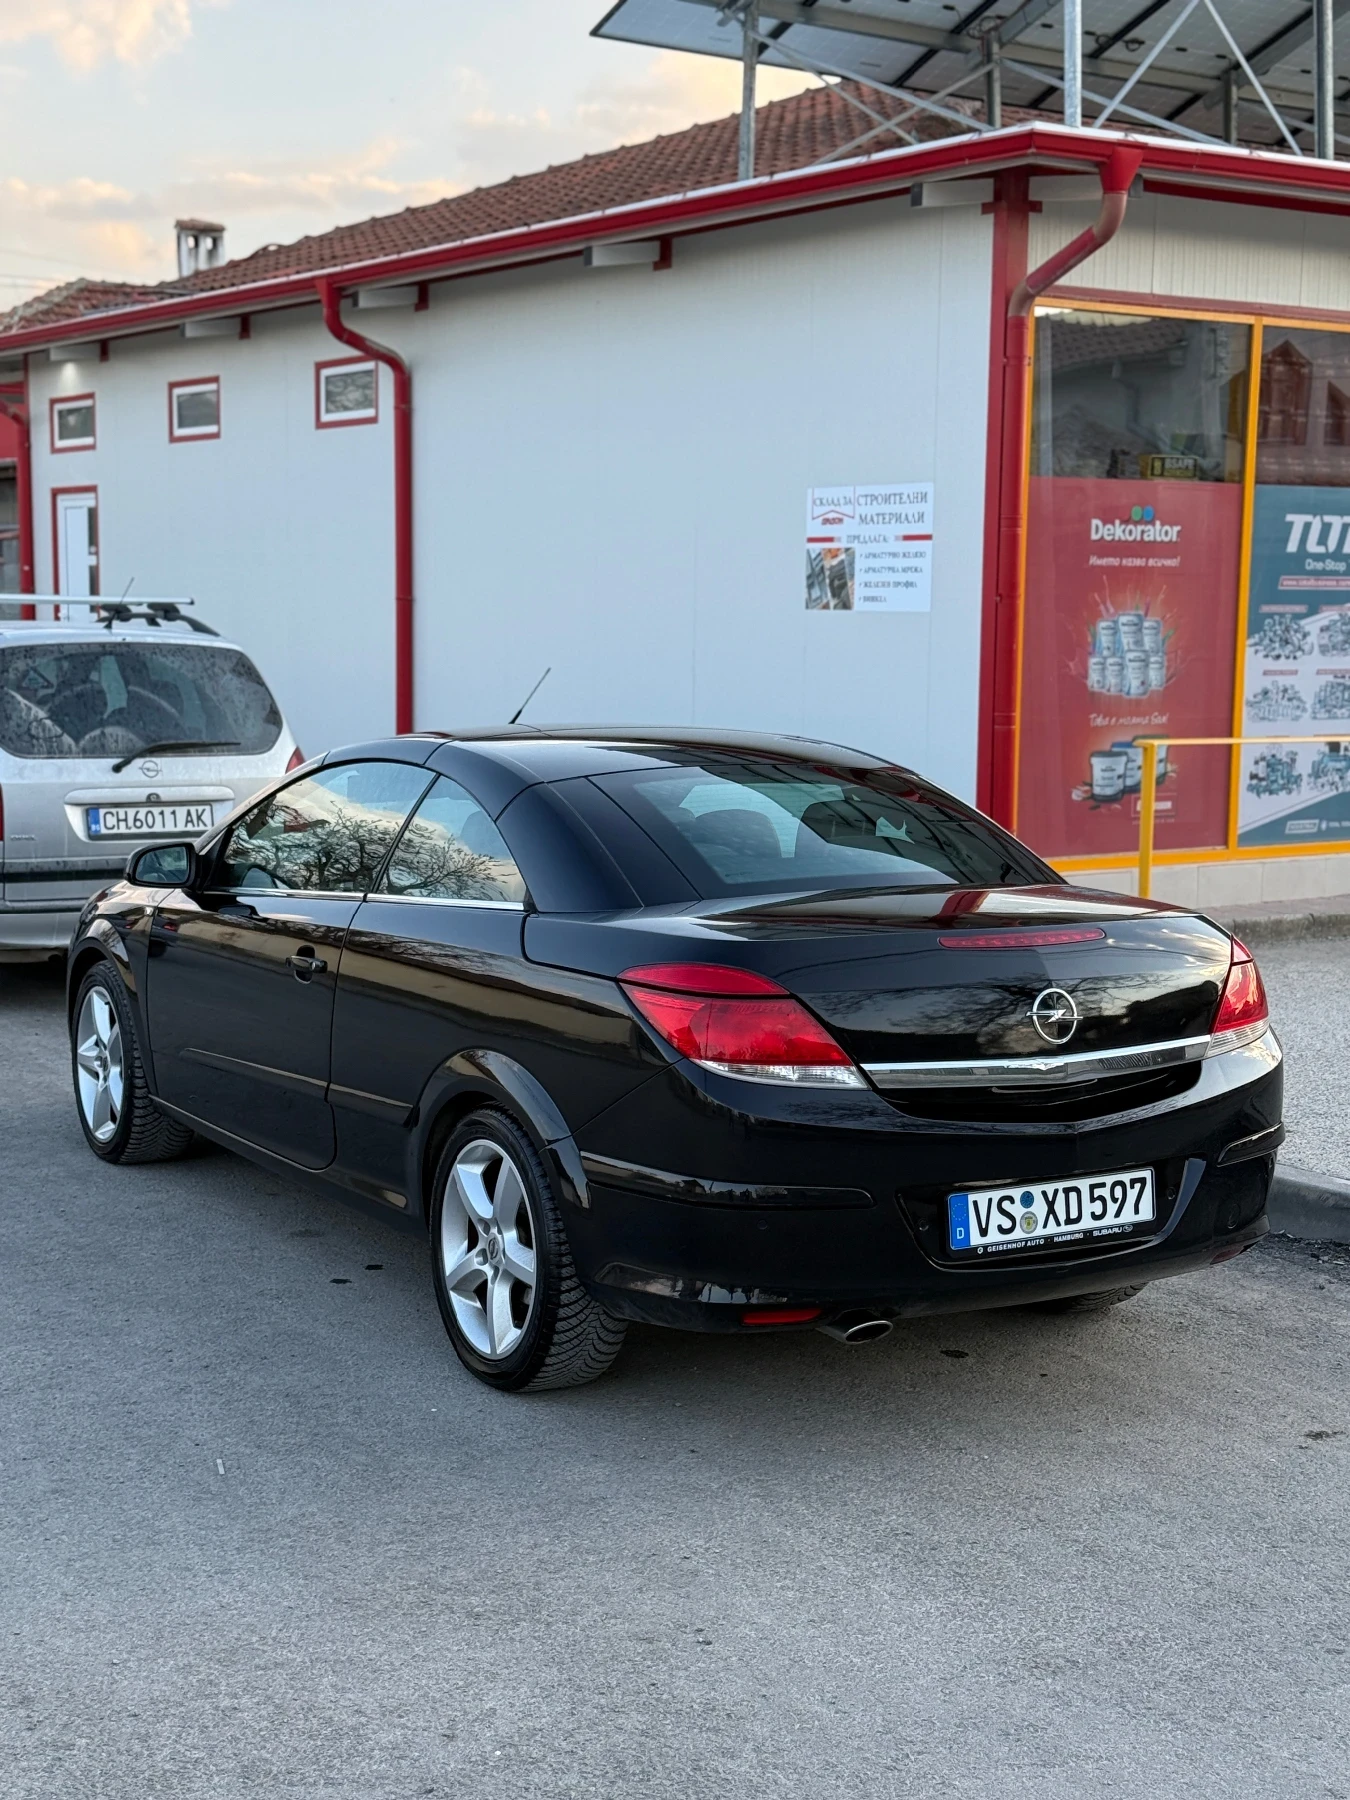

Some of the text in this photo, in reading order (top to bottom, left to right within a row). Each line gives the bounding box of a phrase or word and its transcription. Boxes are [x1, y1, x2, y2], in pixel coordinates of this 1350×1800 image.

[813, 496, 854, 507] СКЛАД ЗА
[856, 491, 928, 507] СТРОИТЕЛНИ
[858, 511, 925, 526] МАТЕРИАЛИ
[1090, 518, 1182, 542] Dekorator
[1304, 558, 1347, 574] One-Stop
[956, 1227, 965, 1240] D
[972, 1194, 1017, 1238] VS
[987, 1242, 1026, 1253] GEISENHOF
[1026, 1237, 1045, 1247] AUTO
[1053, 1232, 1084, 1243] HAMBURG
[1092, 1226, 1123, 1237] SUBARU
